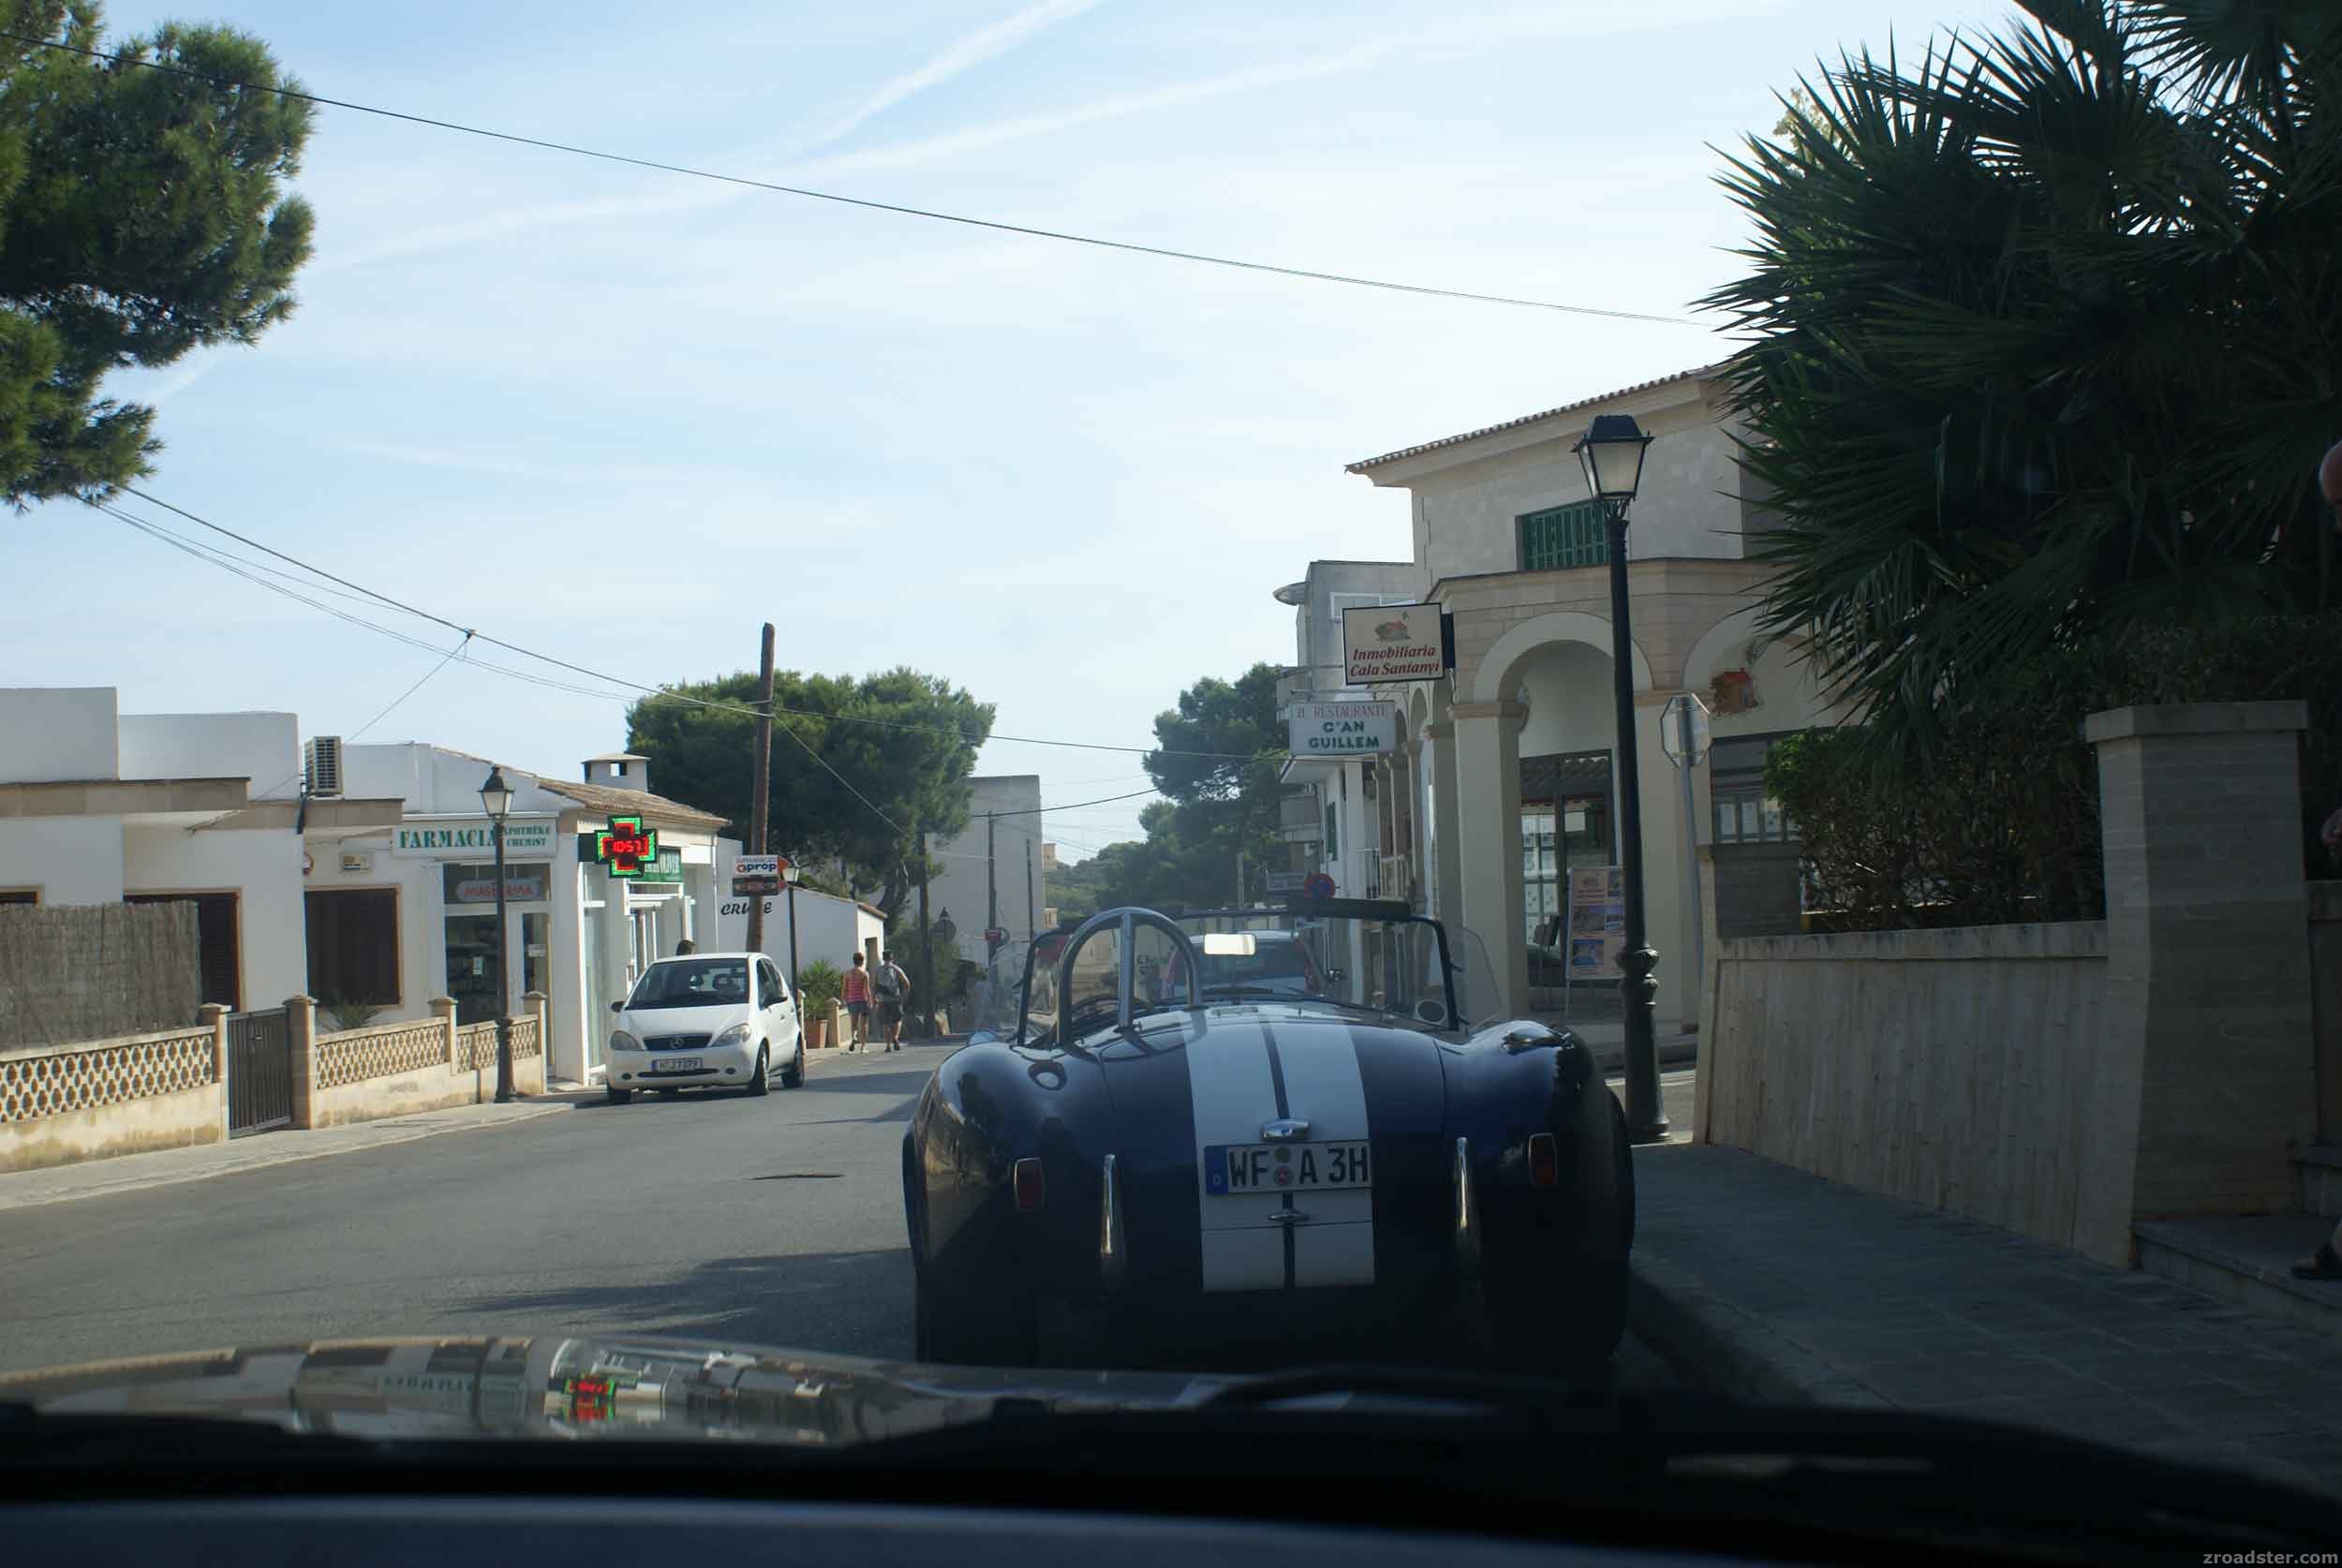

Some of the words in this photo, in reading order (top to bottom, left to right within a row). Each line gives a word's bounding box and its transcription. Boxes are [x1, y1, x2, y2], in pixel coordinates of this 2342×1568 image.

[1353, 644, 1436, 660] Inmobiliaria
[1350, 663, 1380, 676] Cala
[1309, 736, 1379, 748] GUILLEM
[399, 829, 497, 850] FARMACIA
[507, 837, 546, 848] CHEMIST
[1228, 1150, 1270, 1188] WF
[1299, 1147, 1318, 1185] A
[1326, 1146, 1369, 1184] 3H
